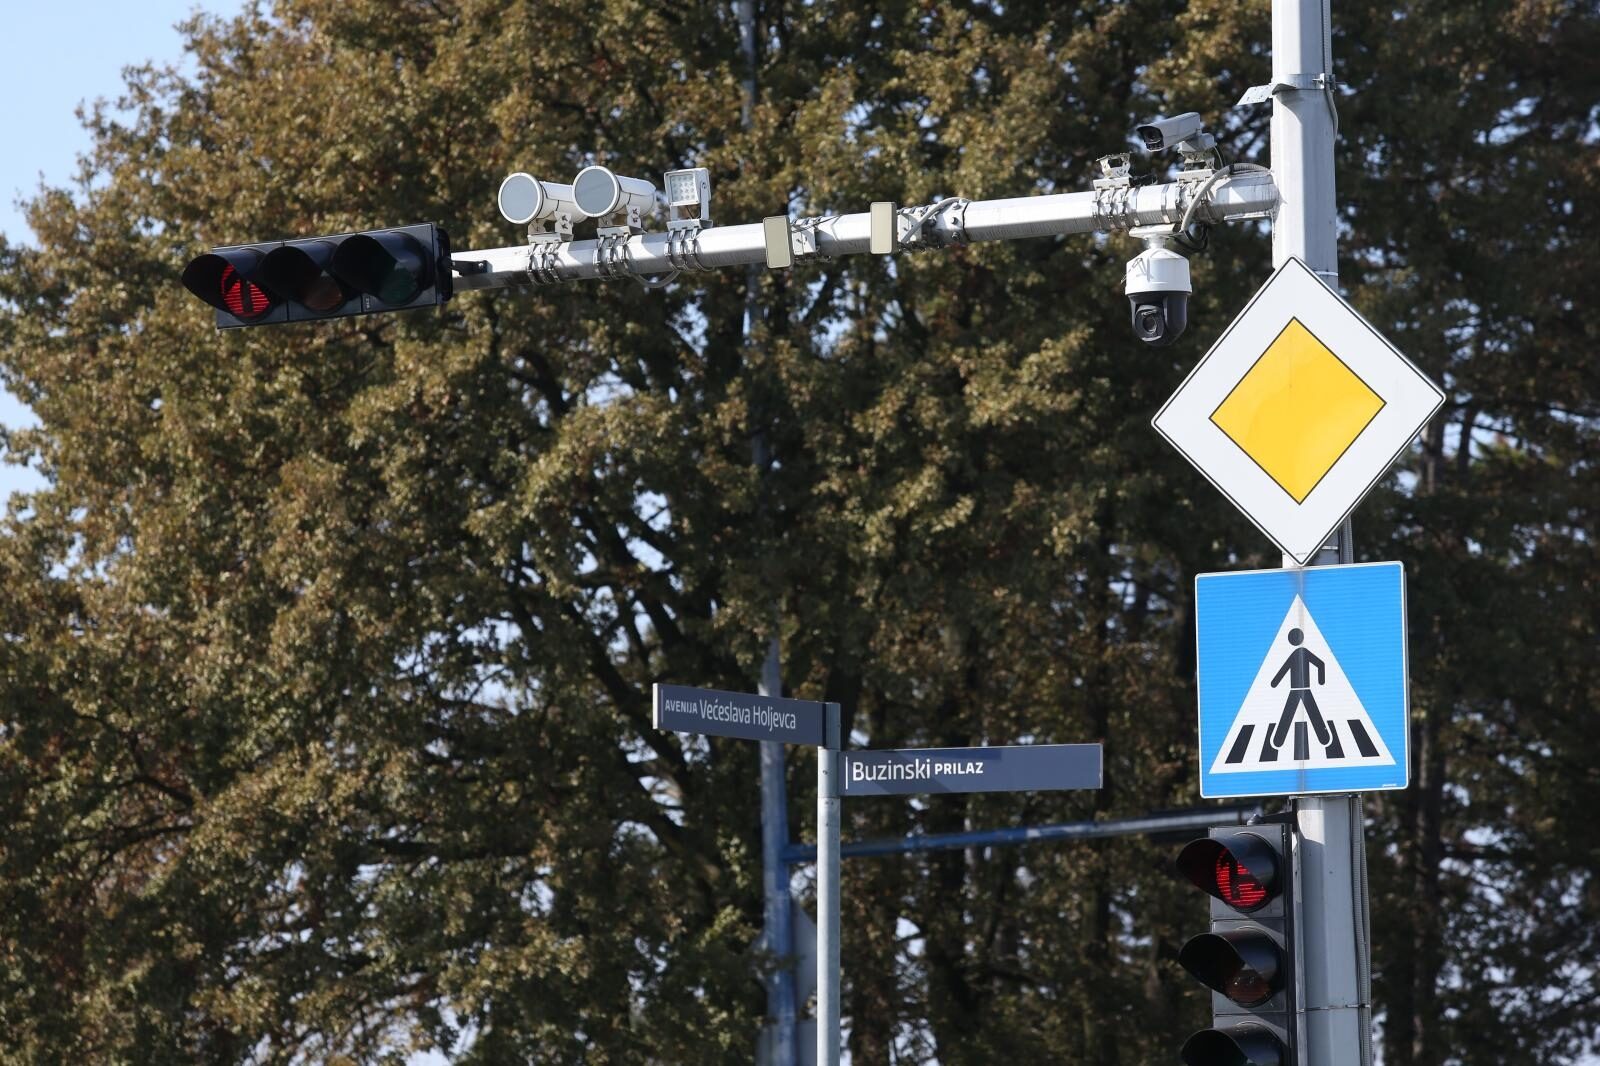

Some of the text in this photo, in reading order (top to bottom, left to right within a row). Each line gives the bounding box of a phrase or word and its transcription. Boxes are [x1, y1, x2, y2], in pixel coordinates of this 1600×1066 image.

[664, 698, 796, 732] AVENIJA Većeslava Holjevca
[852, 758, 984, 781] Buzinski PRILAZ
